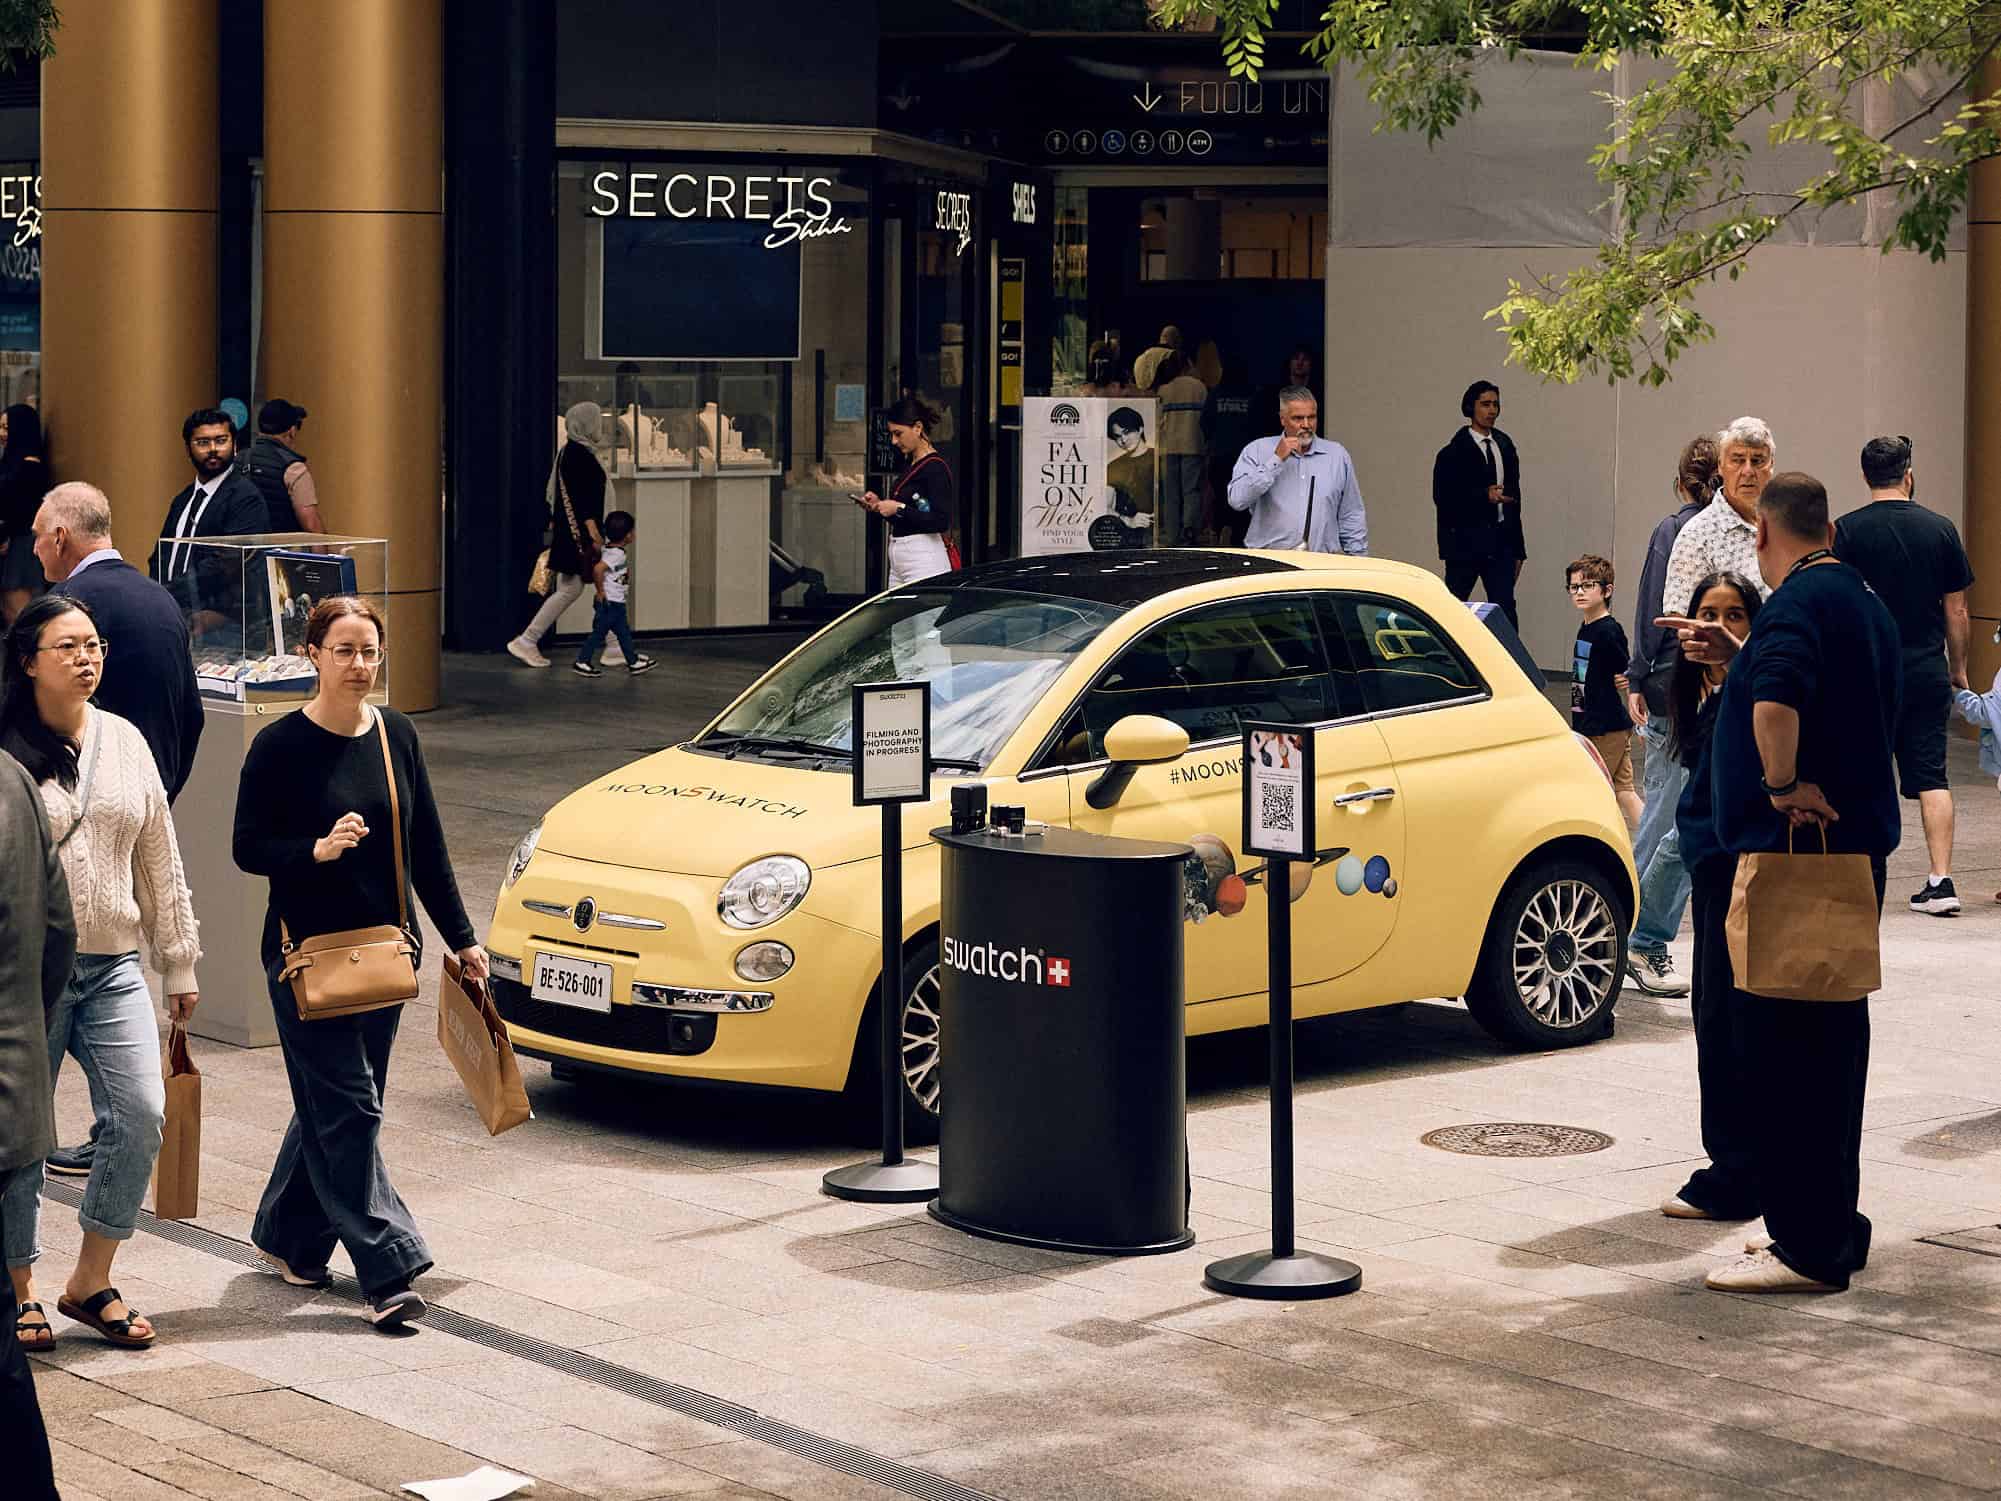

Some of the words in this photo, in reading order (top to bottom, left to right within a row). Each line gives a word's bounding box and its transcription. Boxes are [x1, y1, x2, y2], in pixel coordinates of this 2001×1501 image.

[1179, 81, 1263, 114] FOOD
[591, 171, 832, 220] SECRETS
[936, 190, 971, 231] SECRETS
[764, 208, 852, 249] Shhh
[1040, 464, 1089, 485] SHI
[1044, 486, 1085, 507] ON
[863, 738, 922, 748] PHOTOGRAPHY
[866, 730, 900, 738] FILMING
[901, 728, 919, 737] AND
[866, 749, 875, 757] IN
[876, 745, 920, 756] PROGRESS
[599, 784, 808, 819] MOONSWATCH
[944, 936, 1042, 985] swatch
